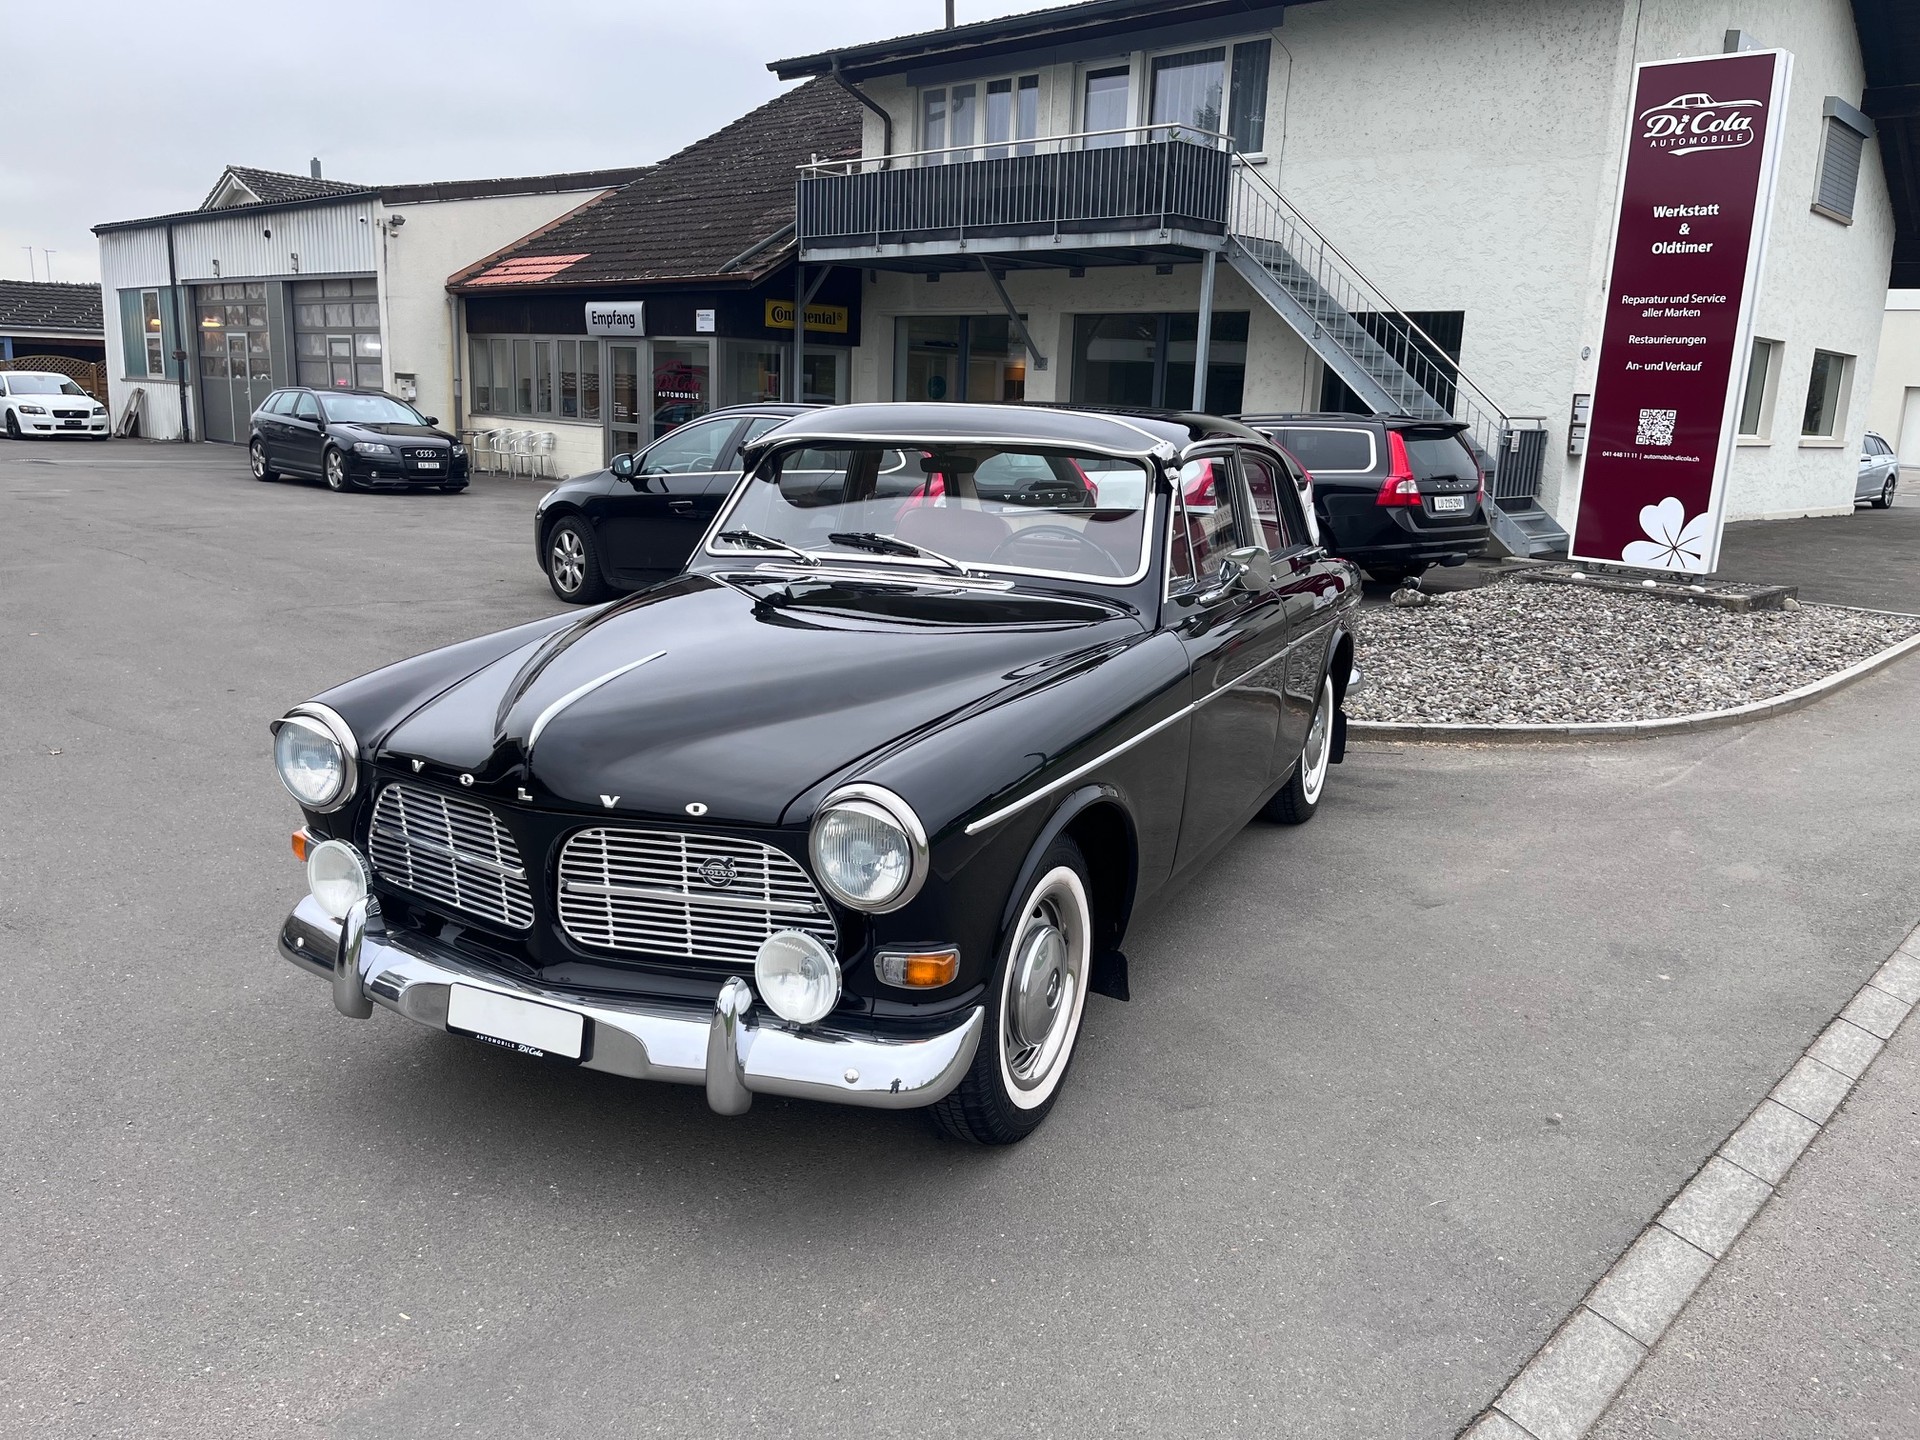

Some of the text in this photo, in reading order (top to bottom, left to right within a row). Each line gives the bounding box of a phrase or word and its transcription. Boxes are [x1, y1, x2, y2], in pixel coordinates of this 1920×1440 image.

[1643, 111, 1752, 138] Di Cola
[1650, 134, 1743, 147] AUTOMOBILE
[1653, 203, 1720, 218] Werkstatt
[1678, 223, 1691, 235] &
[1651, 241, 1713, 254] Oldtimer
[1621, 293, 1727, 306] Reparatur und Service
[1641, 307, 1701, 318] aller Marken
[591, 310, 636, 329] Empfang
[1628, 335, 1707, 347] Restaurierungen
[1625, 361, 1703, 372] An- und Verkauf
[657, 391, 699, 400] AUTOMOBILE
[699, 868, 735, 877] VOLVO
[476, 1034, 515, 1049] AUTOMOBILE
